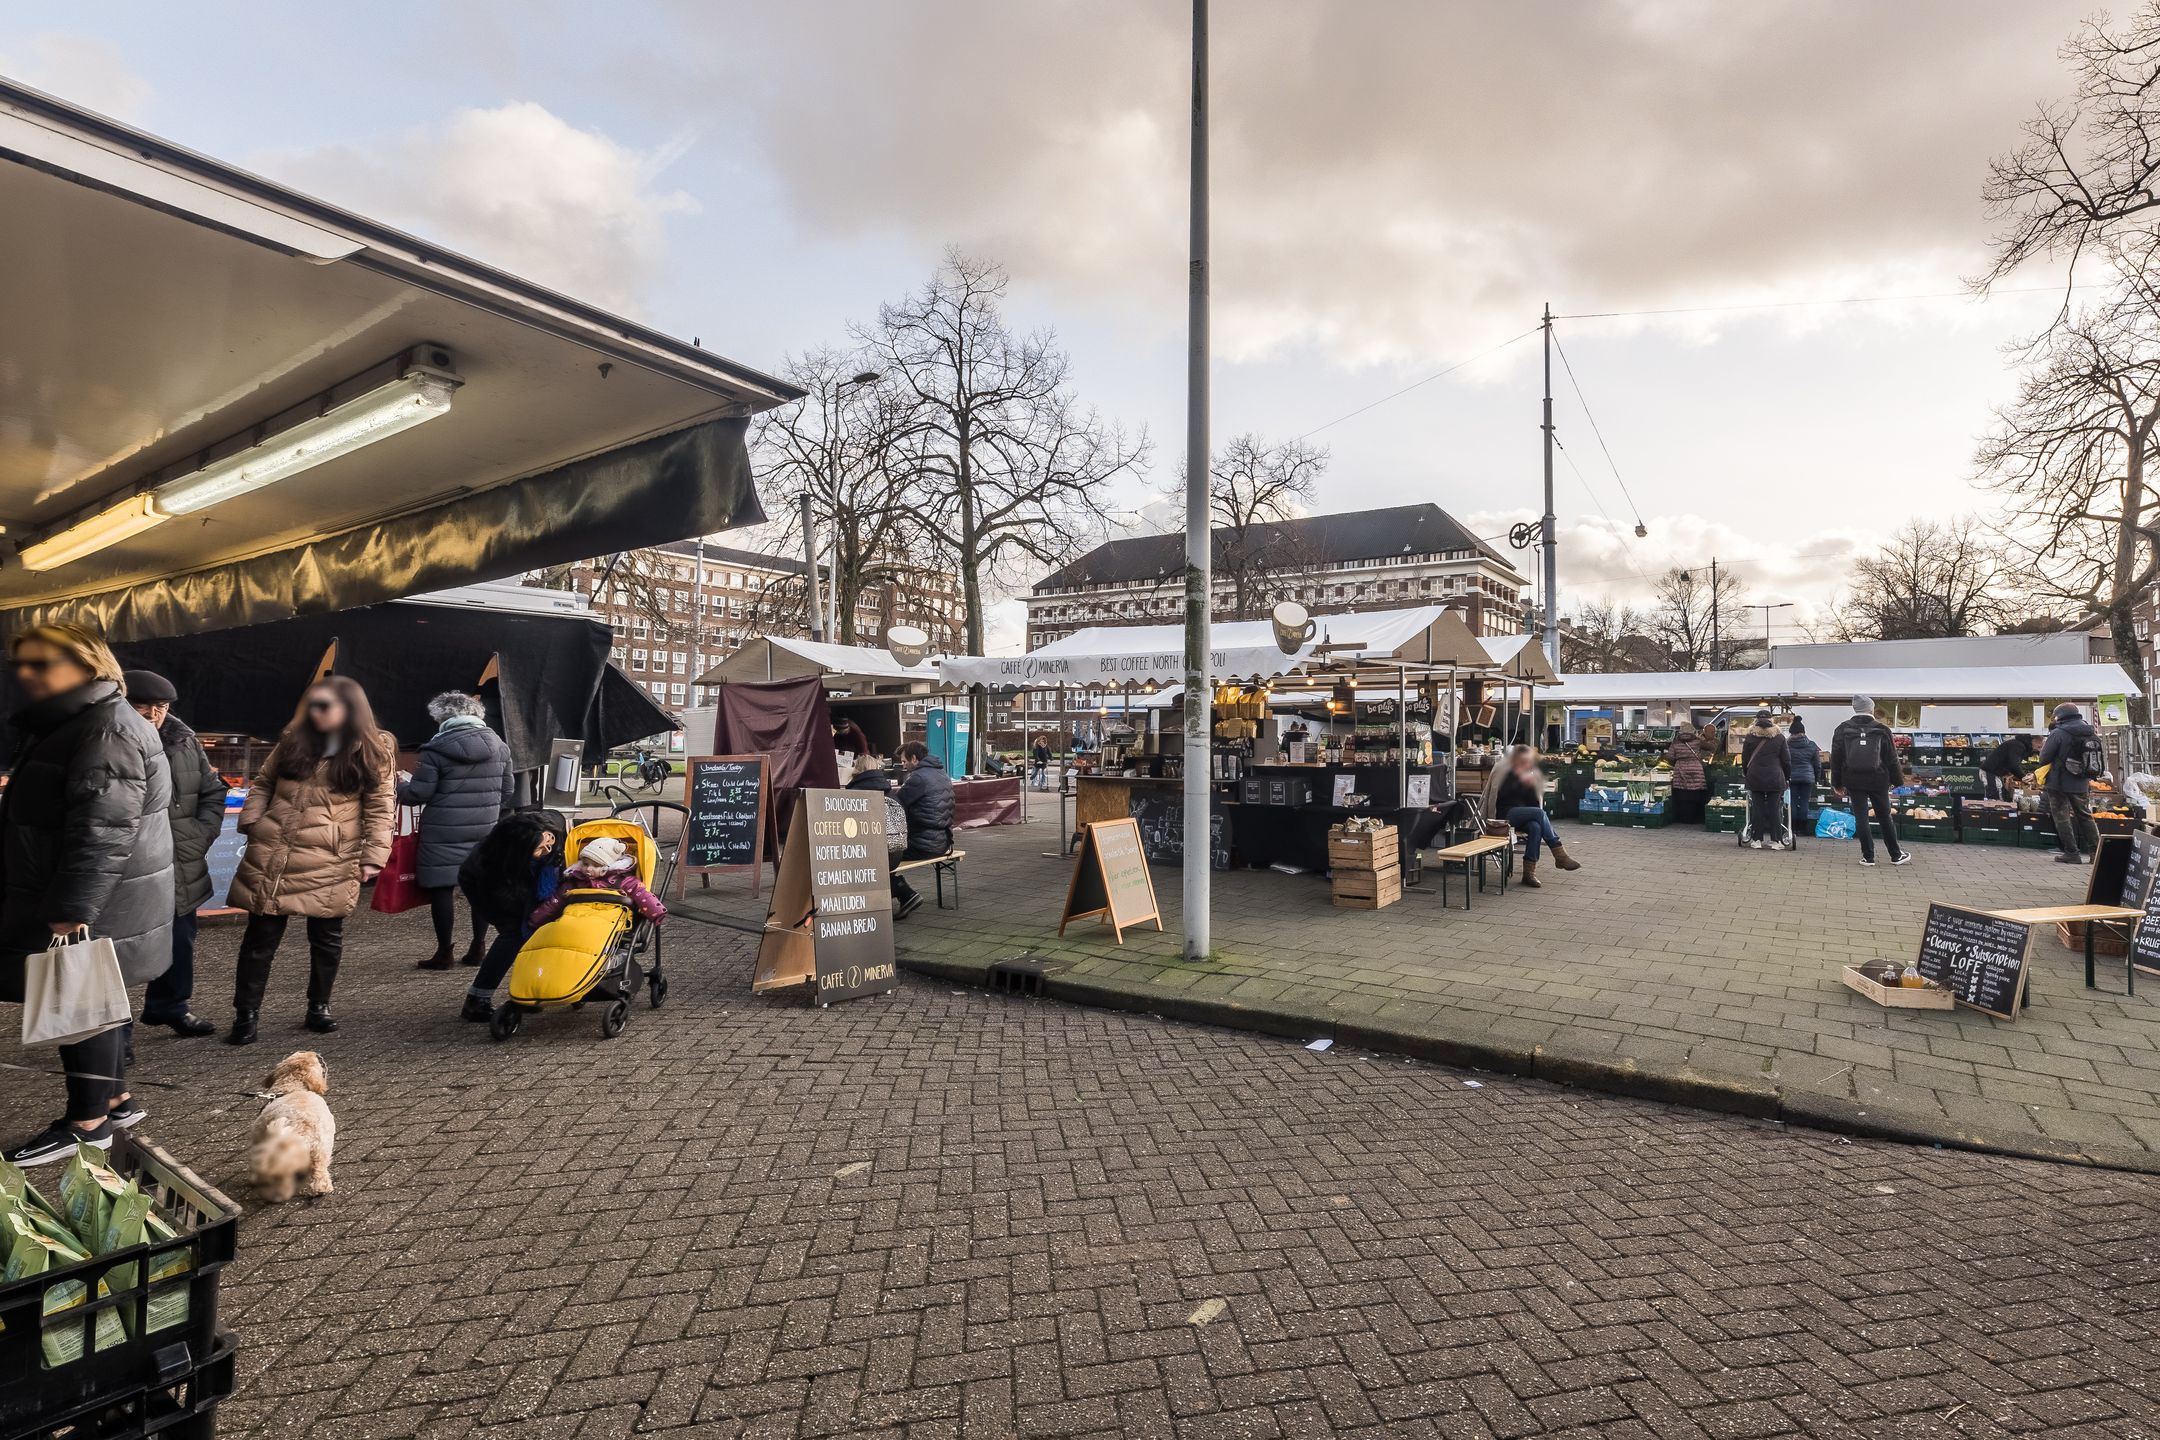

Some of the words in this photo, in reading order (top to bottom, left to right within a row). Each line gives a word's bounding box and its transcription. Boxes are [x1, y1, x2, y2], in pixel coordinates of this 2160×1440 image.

[1039, 658, 1069, 674] MINERVA
[1101, 658, 1117, 672] BEST
[1121, 657, 1149, 671] COFFEE
[1153, 655, 1179, 670] NORTH
[1377, 702, 1394, 713] plus
[1413, 701, 1430, 713] plus
[825, 797, 869, 812] BIOLOGISCHE
[814, 821, 841, 836] COFFEE
[860, 821, 868, 835] TO
[872, 821, 882, 835] GO
[816, 845, 841, 861] KOFFIE
[842, 844, 867, 859] BONEN
[817, 869, 852, 886] GEMALEN
[854, 868, 878, 883] KOFFIE
[821, 895, 866, 912] MAALTIJDEN
[821, 920, 852, 938] BANANA
[853, 917, 877, 934] BREAD
[1930, 934, 1962, 953] Cleanse
[1969, 945, 2021, 970] Subscription
[864, 963, 894, 982] MINERVA
[1950, 955, 1983, 974] LOFE
